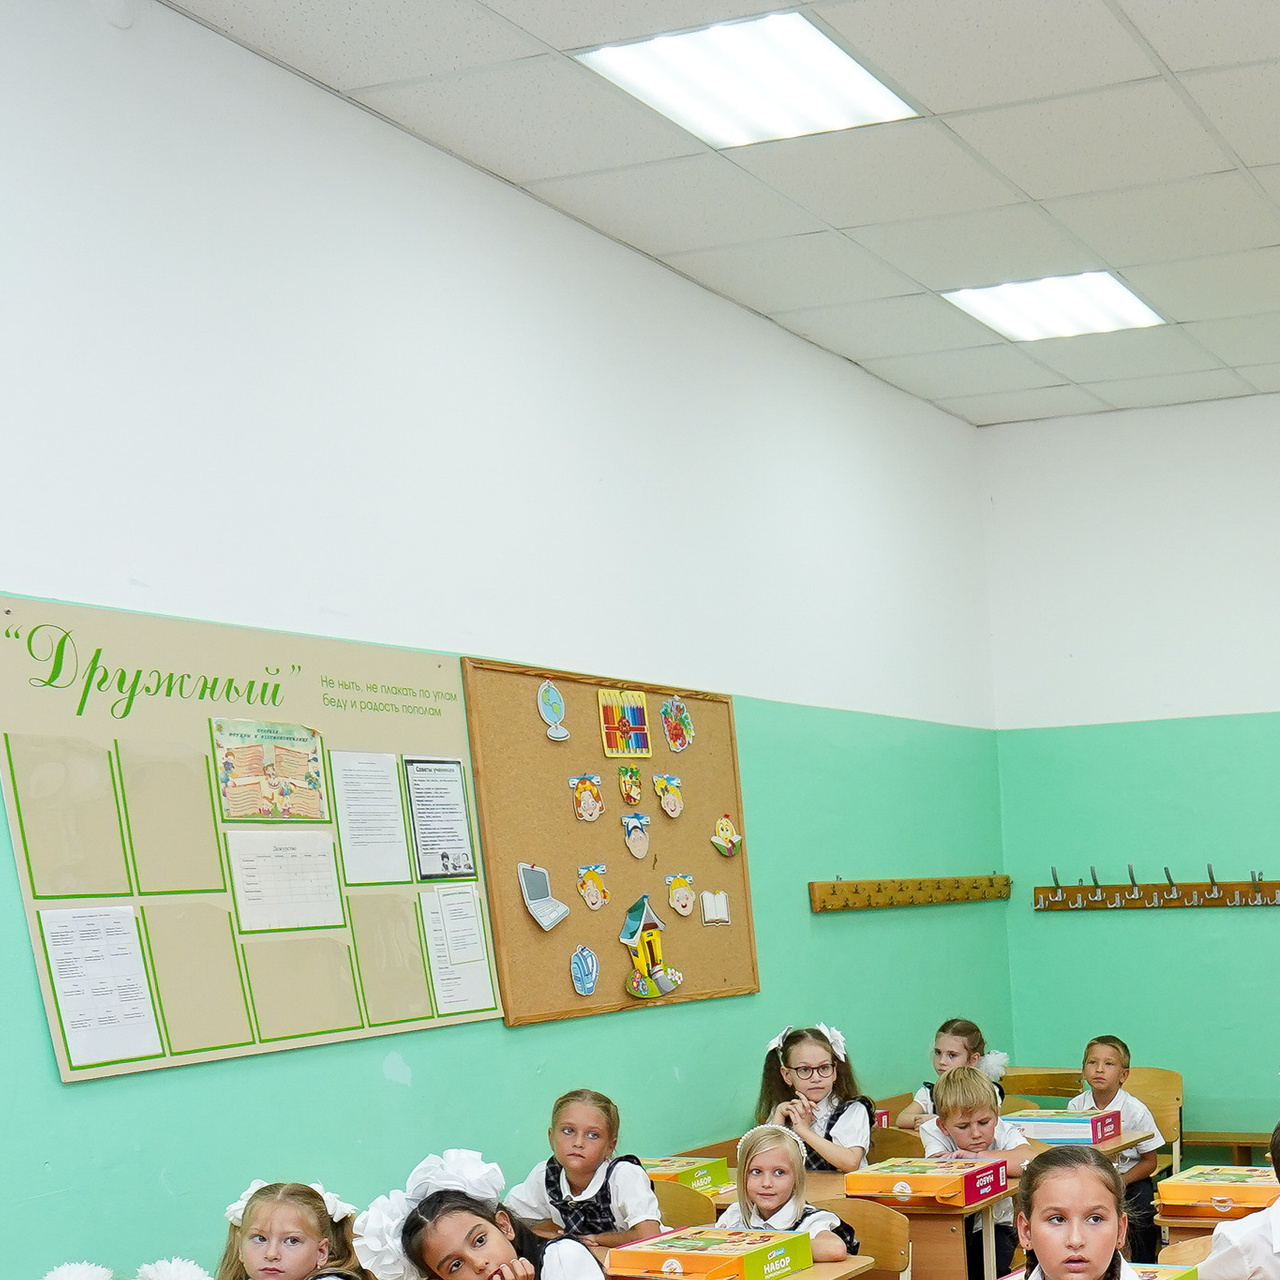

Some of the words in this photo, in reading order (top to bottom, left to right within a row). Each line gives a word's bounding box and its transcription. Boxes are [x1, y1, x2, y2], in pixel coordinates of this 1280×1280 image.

[320, 675, 335, 688] Не
[337, 680, 362, 692] ныть,
[366, 683, 378, 693] не
[380, 684, 417, 698] плакать
[419, 689, 431, 699] по
[433, 690, 457, 702] углам
[322, 692, 348, 711] беду
[350, 699, 358, 709] и
[359, 700, 400, 713] радость
[401, 704, 442, 717] пополам
[763, 1256, 791, 1275] НАБОР
